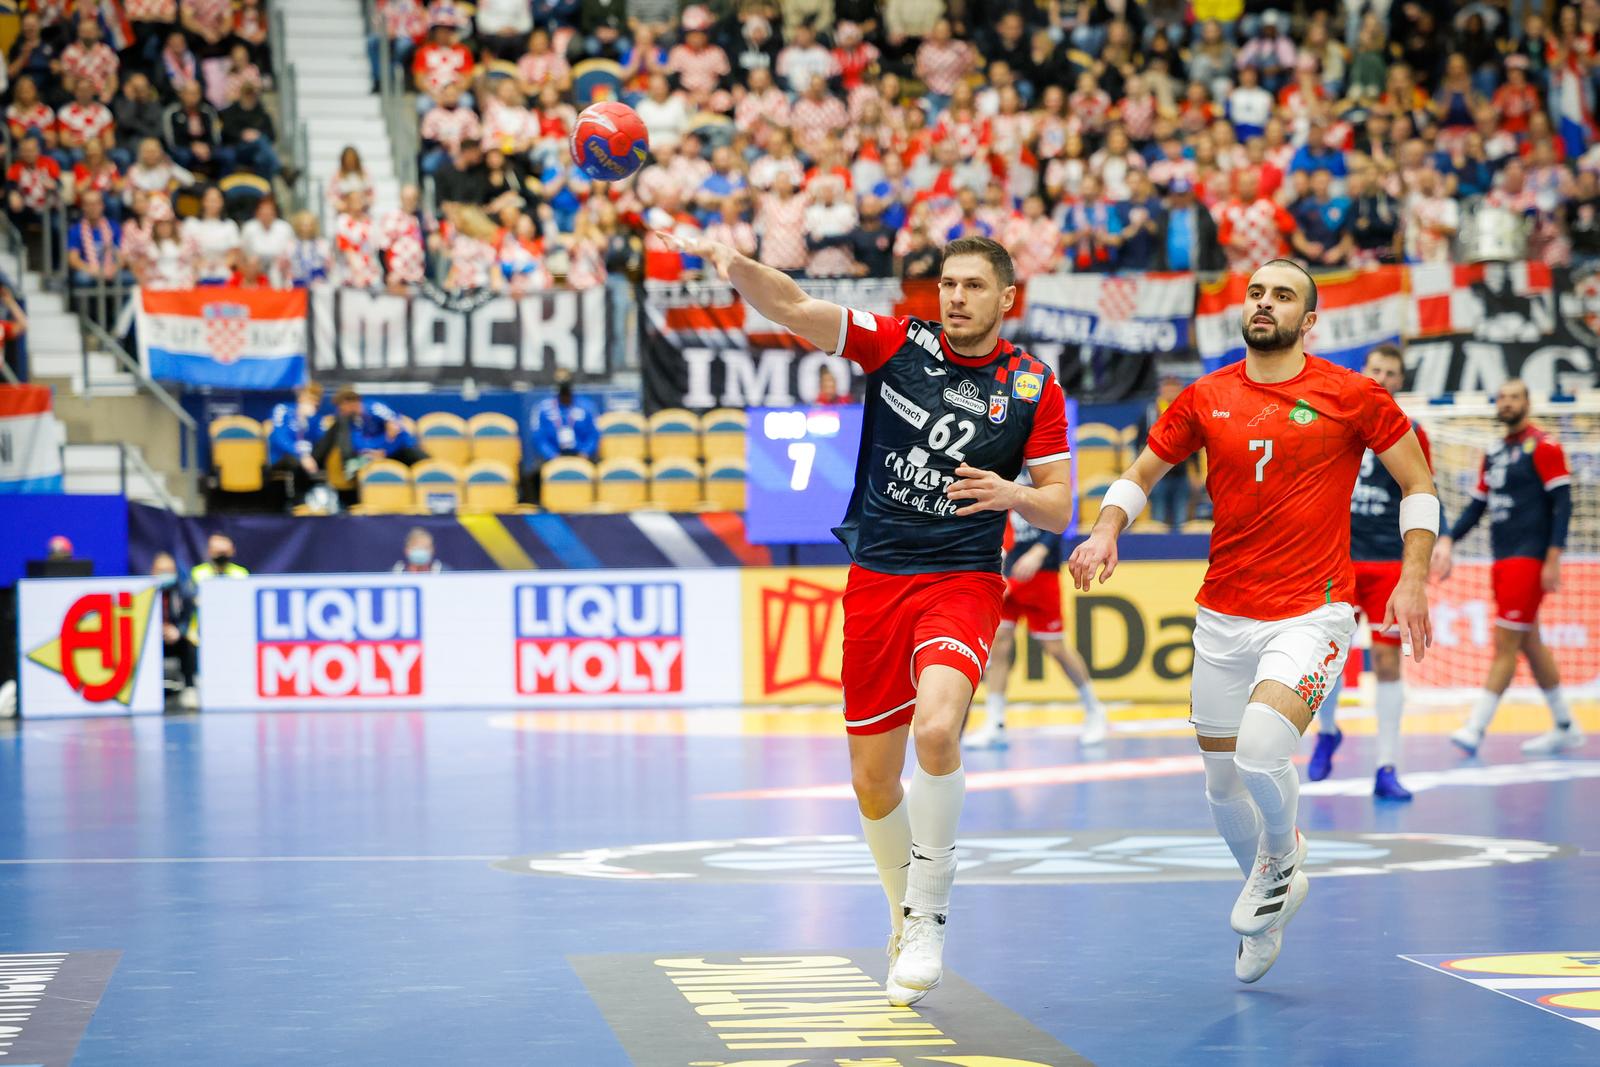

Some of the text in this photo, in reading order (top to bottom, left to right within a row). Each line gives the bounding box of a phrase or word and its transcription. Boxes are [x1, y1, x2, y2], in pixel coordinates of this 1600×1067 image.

[884, 388, 922, 423] telemach
[928, 412, 977, 462] 62
[1248, 439, 1273, 482] 7
[787, 442, 817, 491] 7
[261, 589, 417, 642] LIQUI
[518, 584, 679, 638] LIQUI
[262, 645, 422, 697] MOLY
[519, 641, 681, 692] MOLY
[1323, 640, 1340, 668] 7
[653, 954, 958, 1050] HARTING
